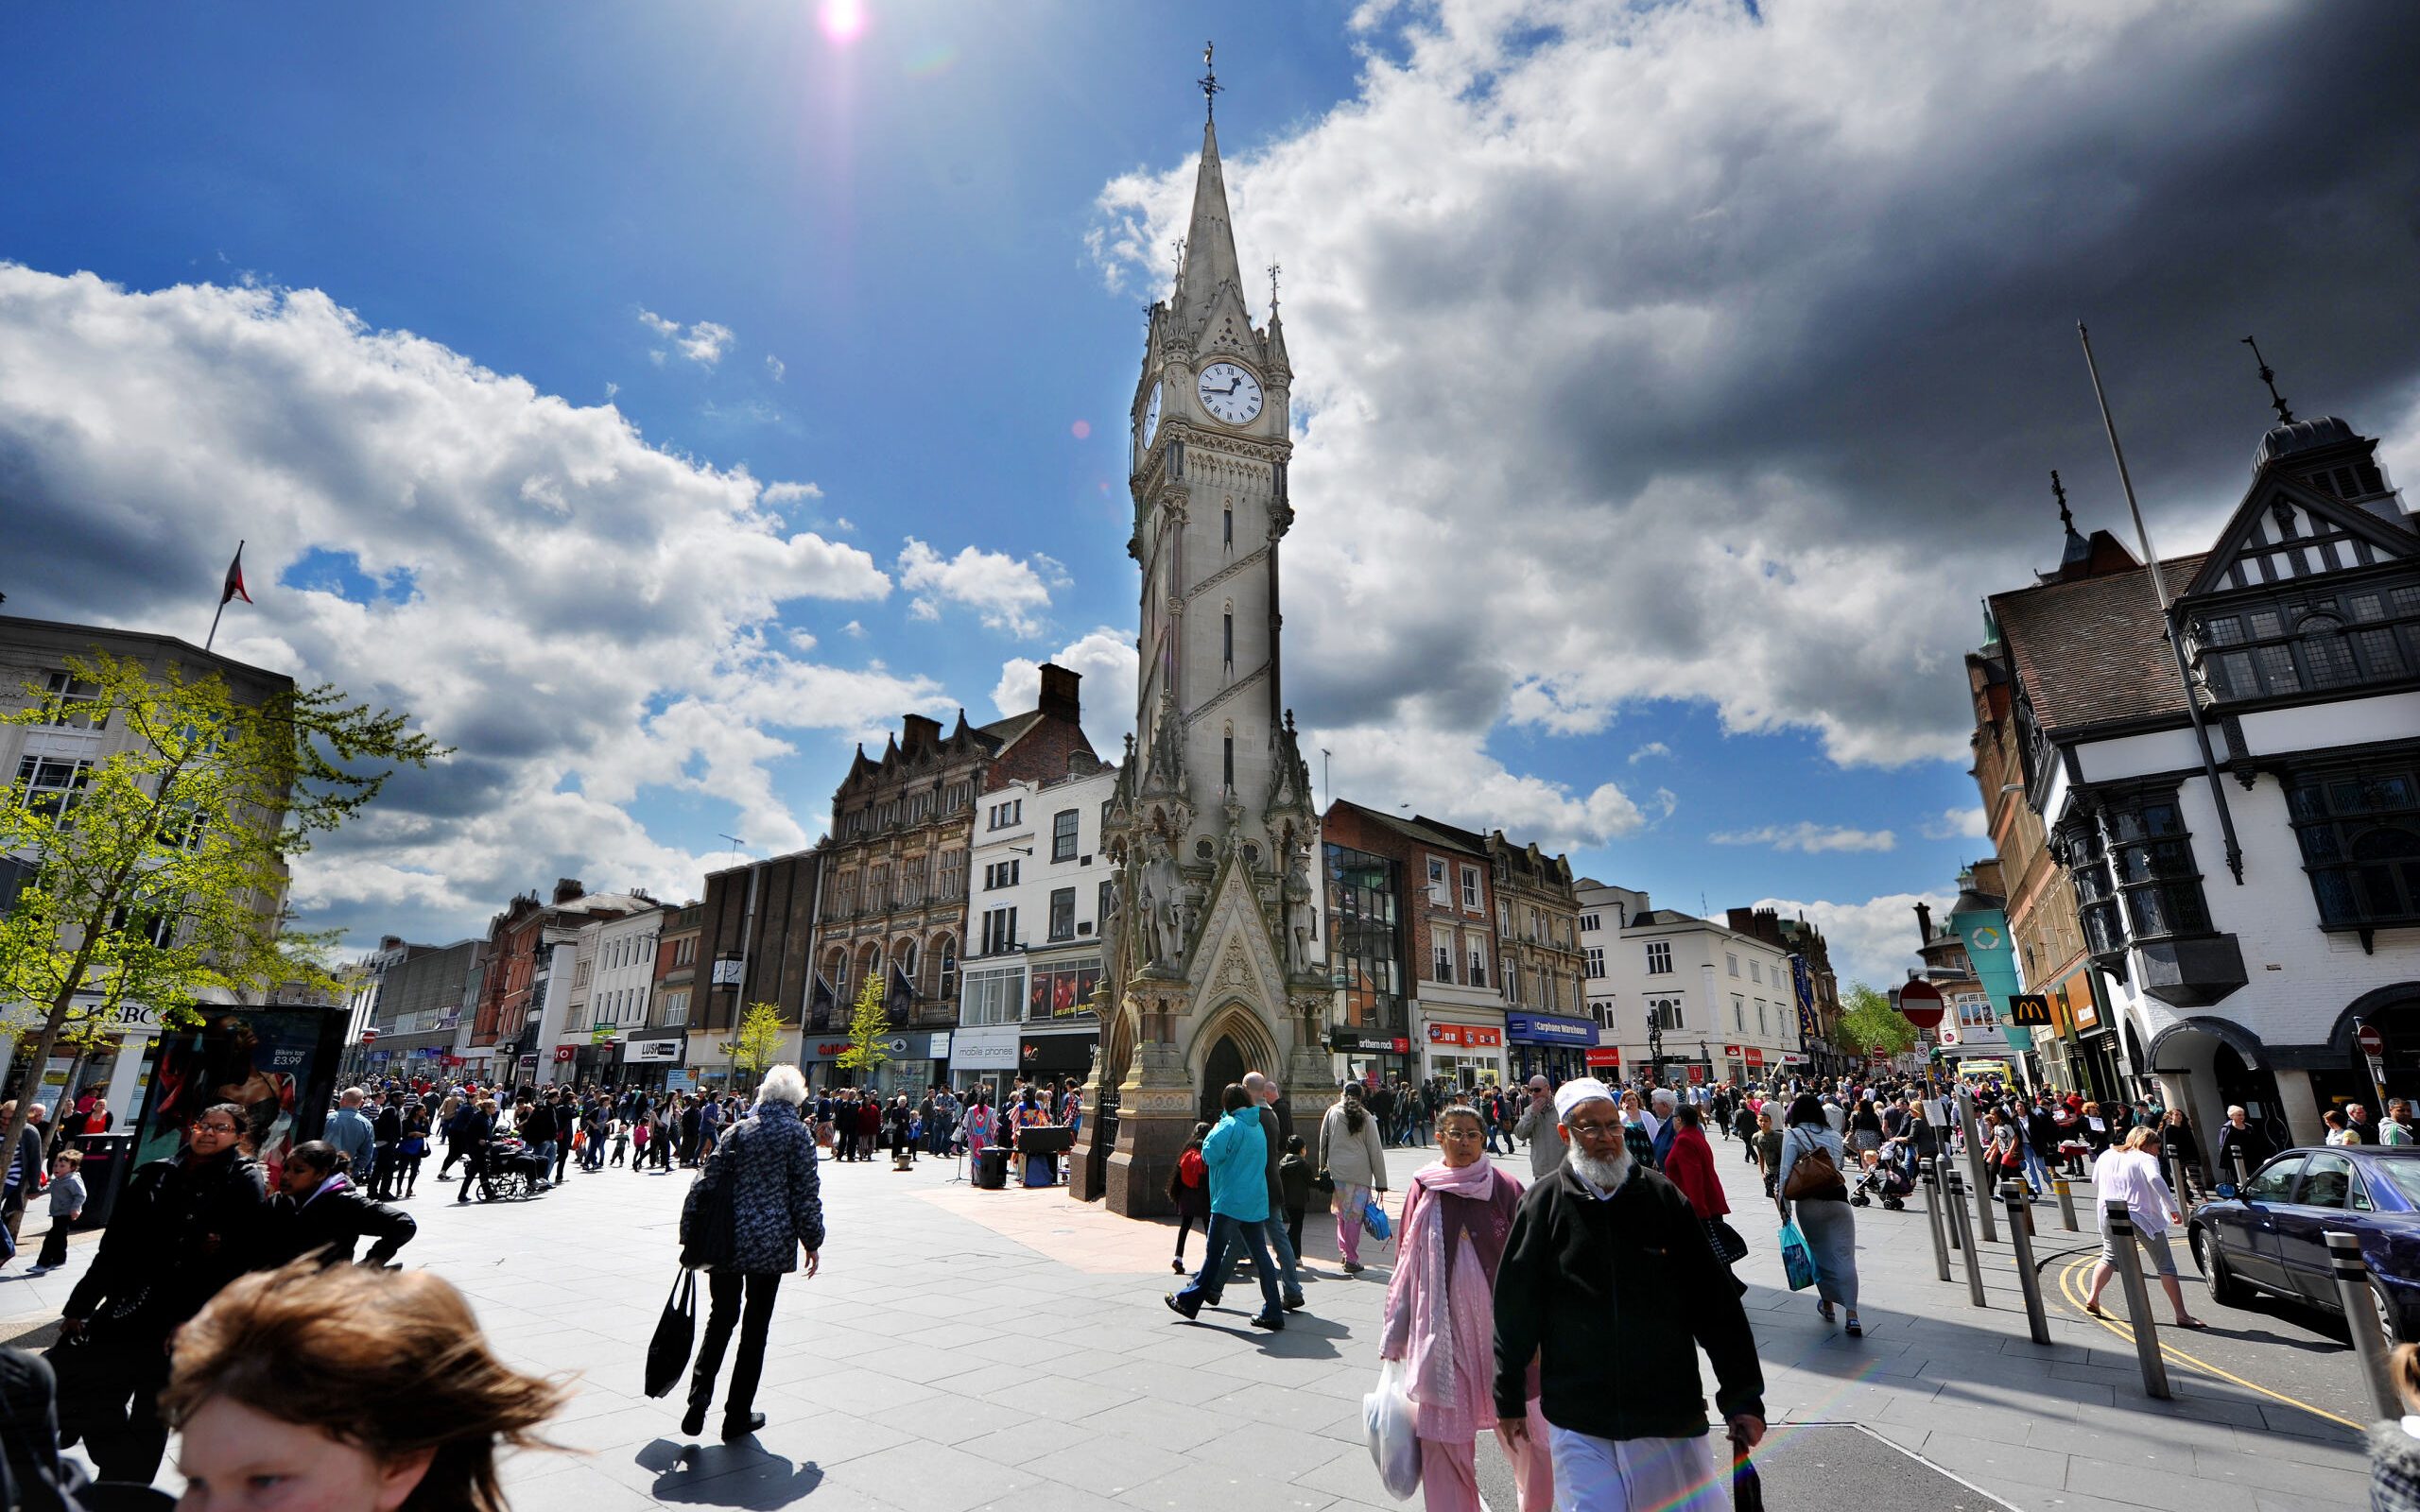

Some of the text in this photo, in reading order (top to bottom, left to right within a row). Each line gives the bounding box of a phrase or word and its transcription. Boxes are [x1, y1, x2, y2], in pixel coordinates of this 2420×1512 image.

[1536, 1022, 1561, 1033] Carphone
[1561, 1024, 1587, 1036] Warehouse
[1358, 1039, 1392, 1050] orthern rock
[959, 1046, 1012, 1057] mobile phones
[273, 1057, 302, 1065] £3.99
